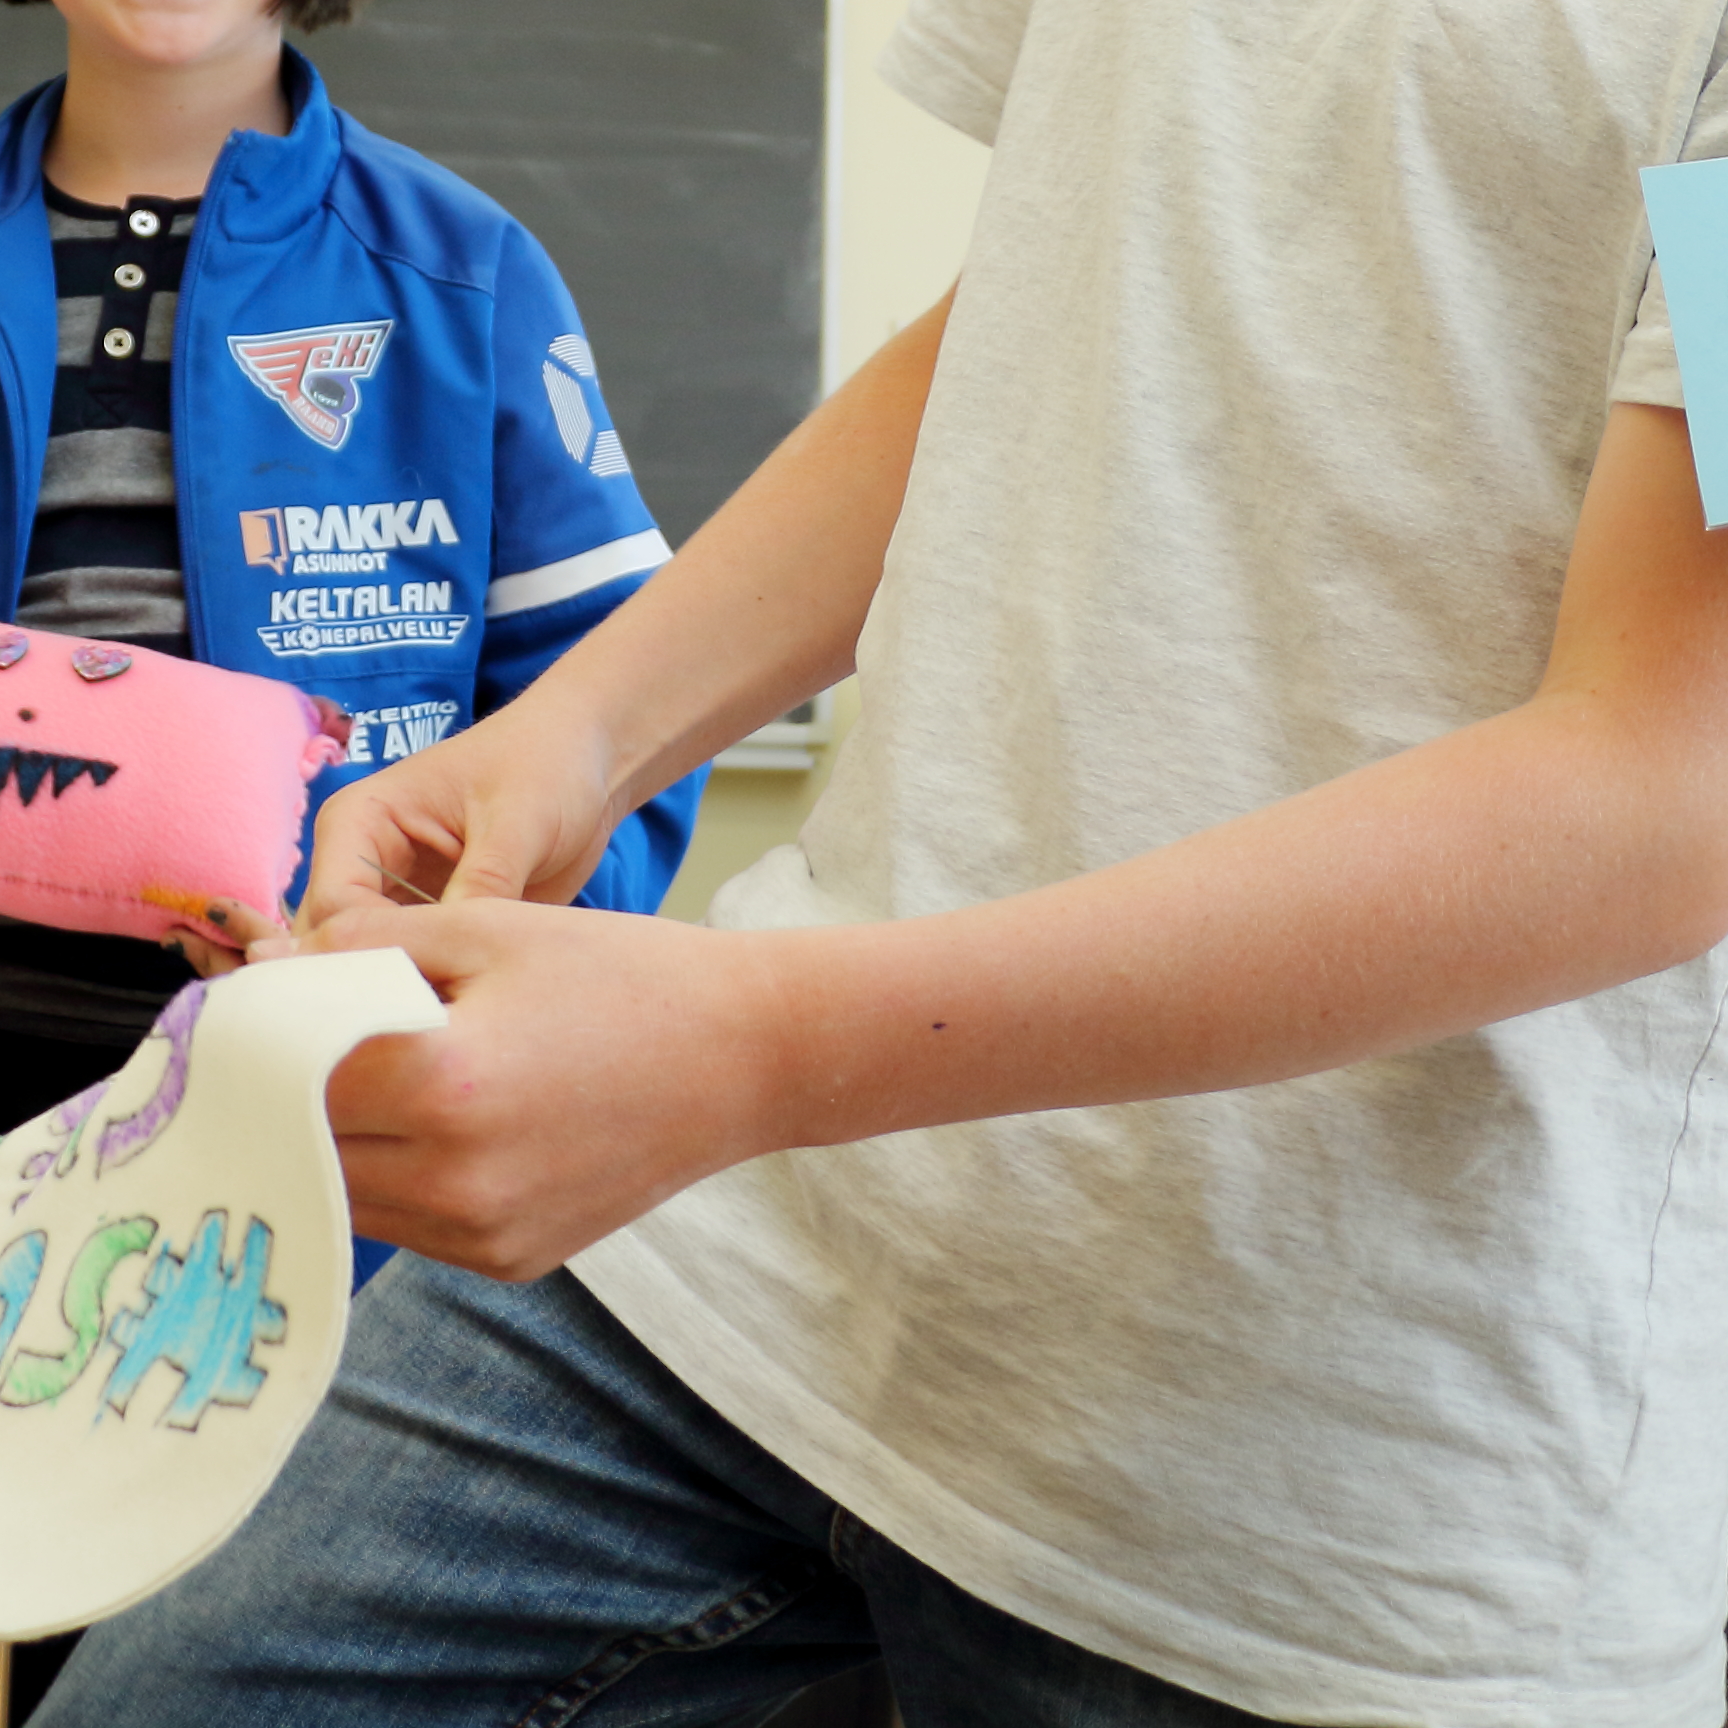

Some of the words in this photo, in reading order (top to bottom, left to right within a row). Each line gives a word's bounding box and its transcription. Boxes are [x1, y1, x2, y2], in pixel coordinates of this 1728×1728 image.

[284, 498, 460, 552] RAKKA
[292, 551, 389, 575] ASUNNOT
[270, 580, 452, 623] KELTALAN
[282, 620, 449, 650] KONEPALVELU
[348, 699, 459, 725] KEITTIÖ
